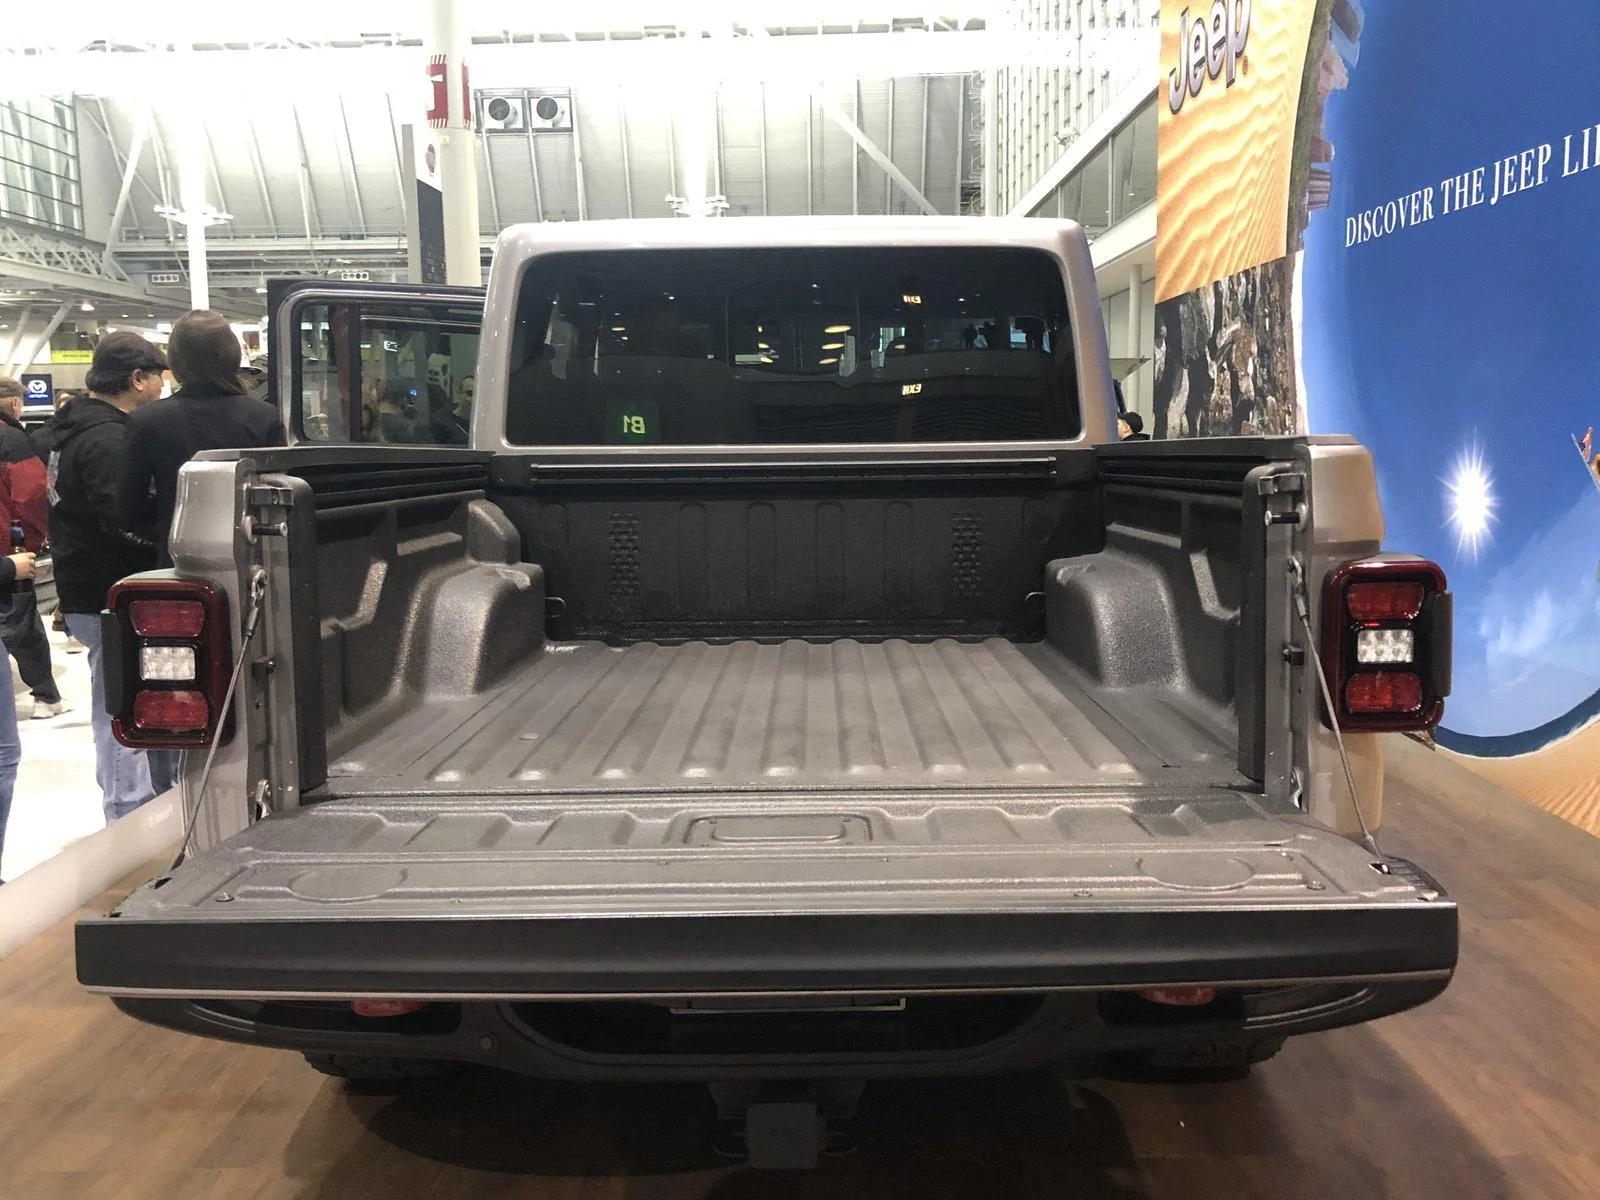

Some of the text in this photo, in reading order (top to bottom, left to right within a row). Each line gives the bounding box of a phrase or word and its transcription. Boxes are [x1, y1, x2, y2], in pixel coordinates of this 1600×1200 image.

[1168, 0, 1252, 115] Jeep
[1345, 186, 1435, 248] DISCOVER
[1440, 166, 1485, 215] THE
[1490, 143, 1552, 206] JEEP
